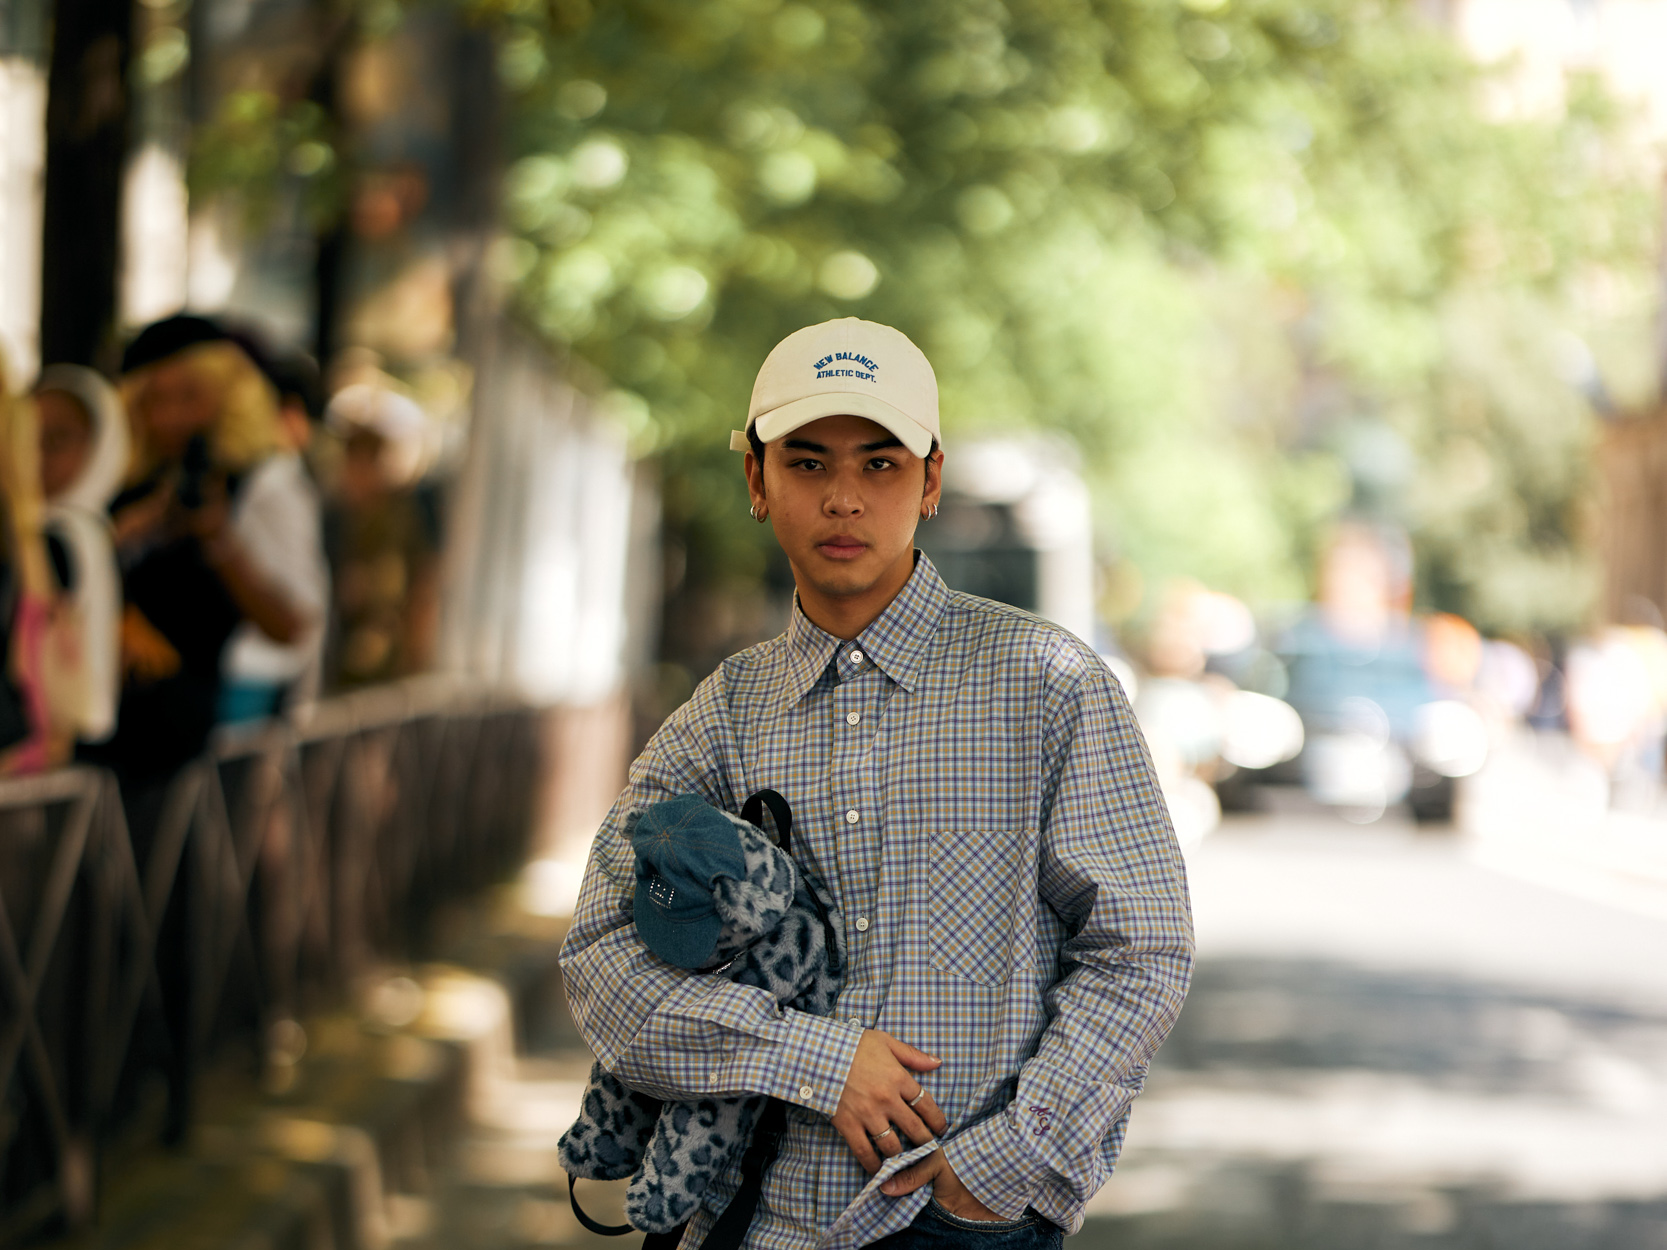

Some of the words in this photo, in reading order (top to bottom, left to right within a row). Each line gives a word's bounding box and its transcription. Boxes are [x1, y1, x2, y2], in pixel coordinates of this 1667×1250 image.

[813, 354, 833, 370] NEW
[835, 352, 879, 372] BALANCE
[816, 369, 854, 379] ATHLETIC
[855, 370, 876, 383] DEPT.
